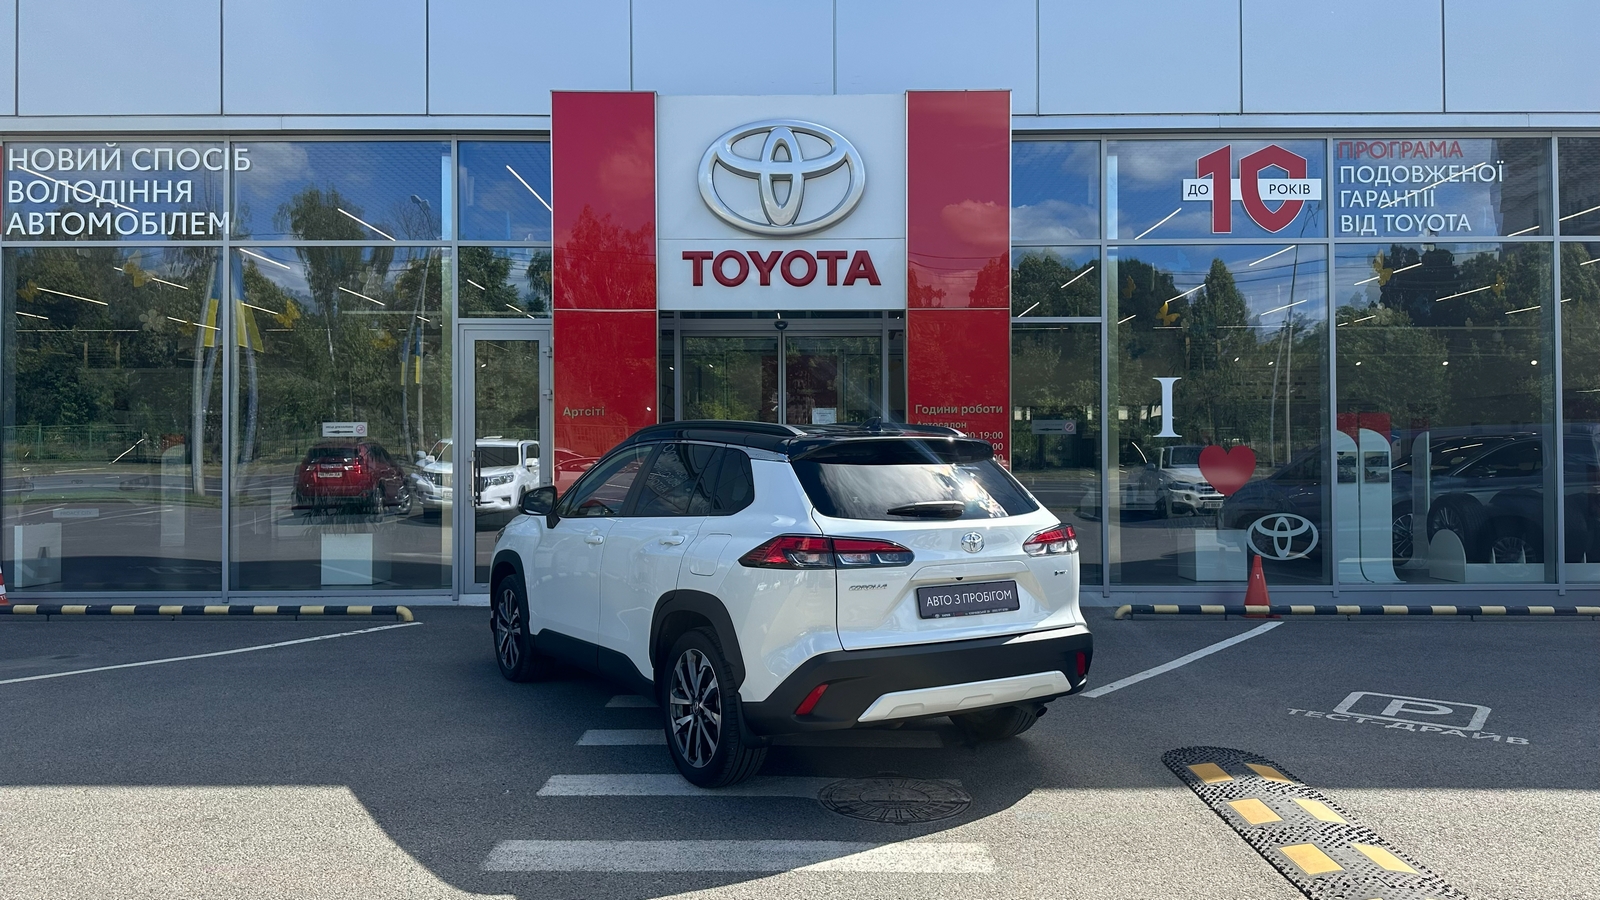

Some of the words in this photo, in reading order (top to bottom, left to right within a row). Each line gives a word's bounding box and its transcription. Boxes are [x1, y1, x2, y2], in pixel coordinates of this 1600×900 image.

[8, 142, 123, 171] НОВИЙ
[131, 148, 251, 172] СПОСІБ
[1339, 140, 1464, 159] ПРОГРАМА
[1340, 160, 1503, 185] ПОДОВЖЕНОЇ
[8, 181, 193, 206] ВОЛОДІННЯ
[1187, 184, 1209, 198] ДО
[1197, 144, 1308, 234] 10
[1268, 183, 1311, 196] РОКІВ
[1340, 186, 1436, 208] ГАРАНТІЇ
[6, 212, 230, 236] АВТОМОБІЛЕМ
[1341, 215, 1378, 235] ВІД
[1383, 213, 1472, 233] TOYOTA
[682, 250, 881, 287] TOYOTA
[563, 406, 605, 419] Артсіті
[915, 404, 958, 415] Години
[961, 404, 1003, 416] роботи
[926, 594, 952, 607] АВТО
[954, 594, 961, 605] З
[962, 590, 1013, 604] ПРОБІГОМ
[1287, 707, 1530, 745] ТЕСТ-ДРАЙВ
